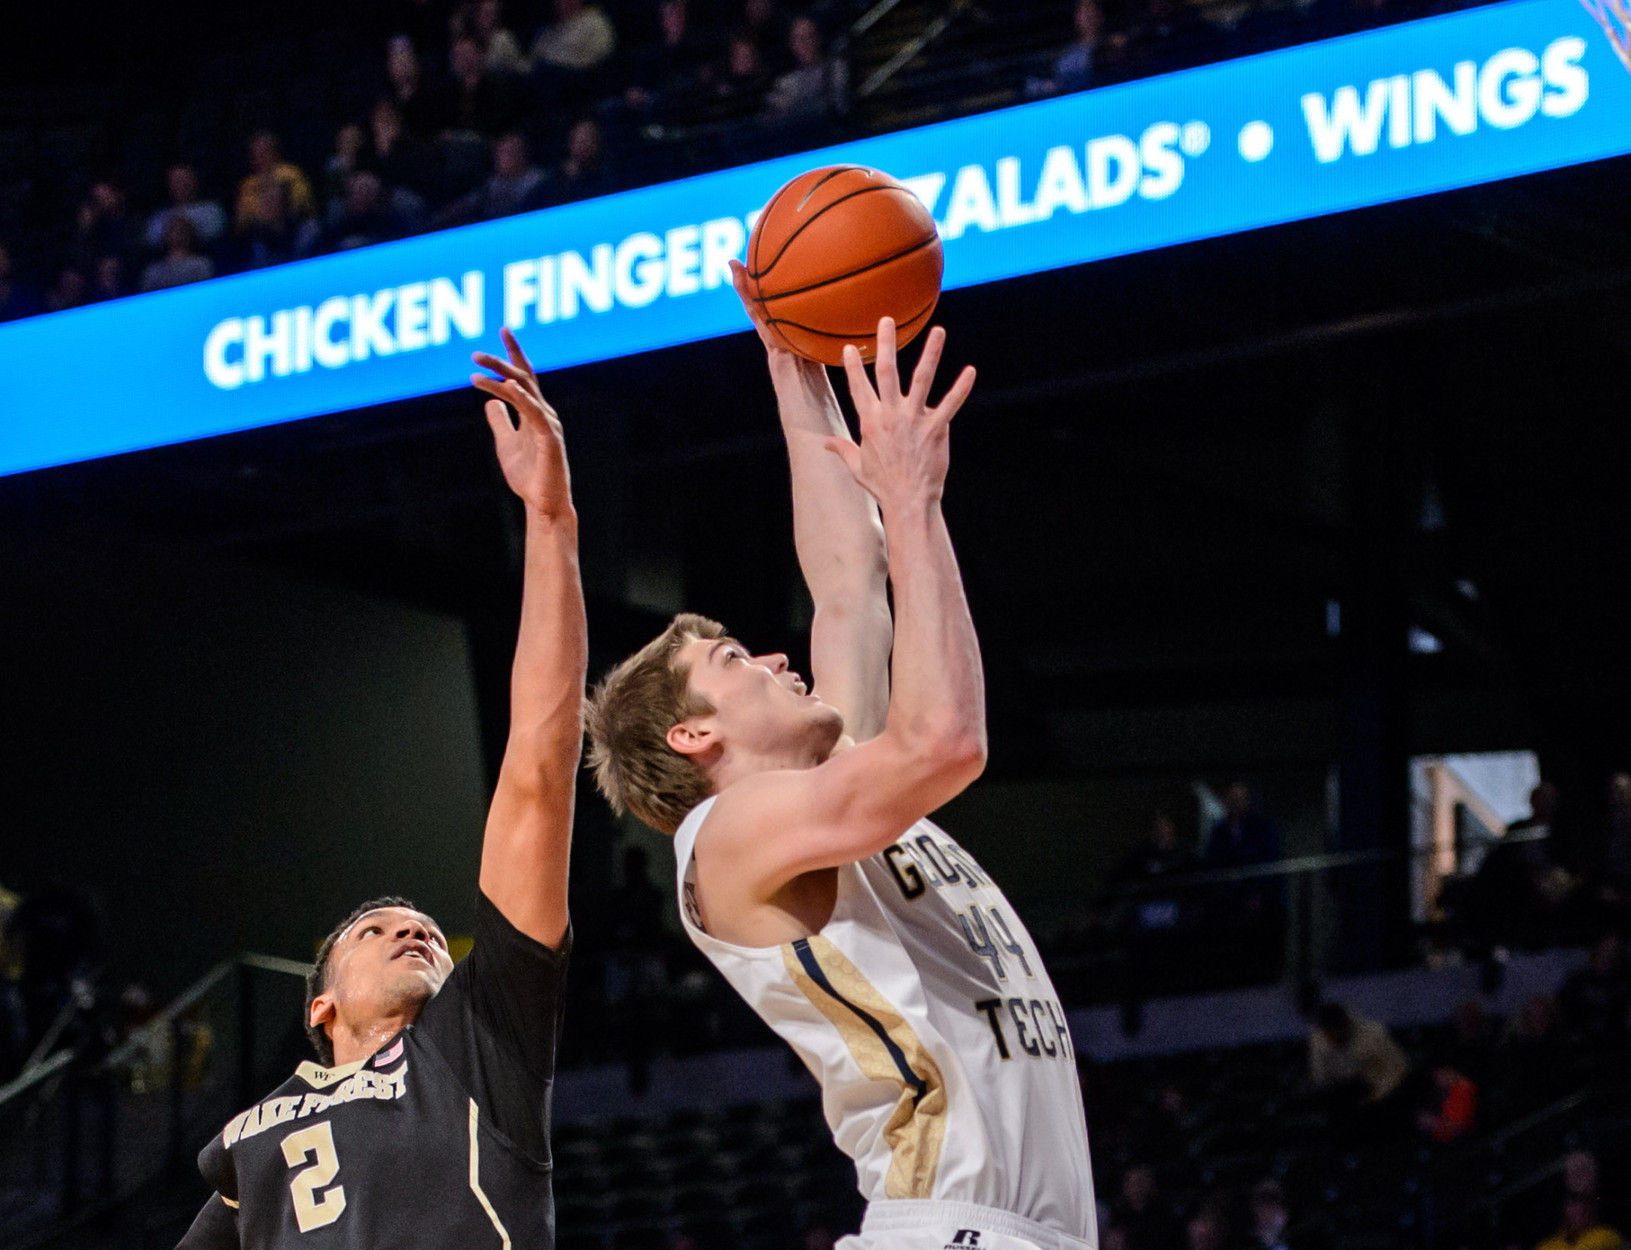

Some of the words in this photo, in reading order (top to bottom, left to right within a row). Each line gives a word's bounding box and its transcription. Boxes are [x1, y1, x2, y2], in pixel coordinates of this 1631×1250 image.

[205, 270, 485, 389] CHICKEN
[503, 206, 763, 330] FINGER
[1303, 37, 1588, 163] WINGS
[976, 997, 1074, 1061] TECH
[222, 1095, 303, 1149] WAKE
[280, 1120, 347, 1233] 2
